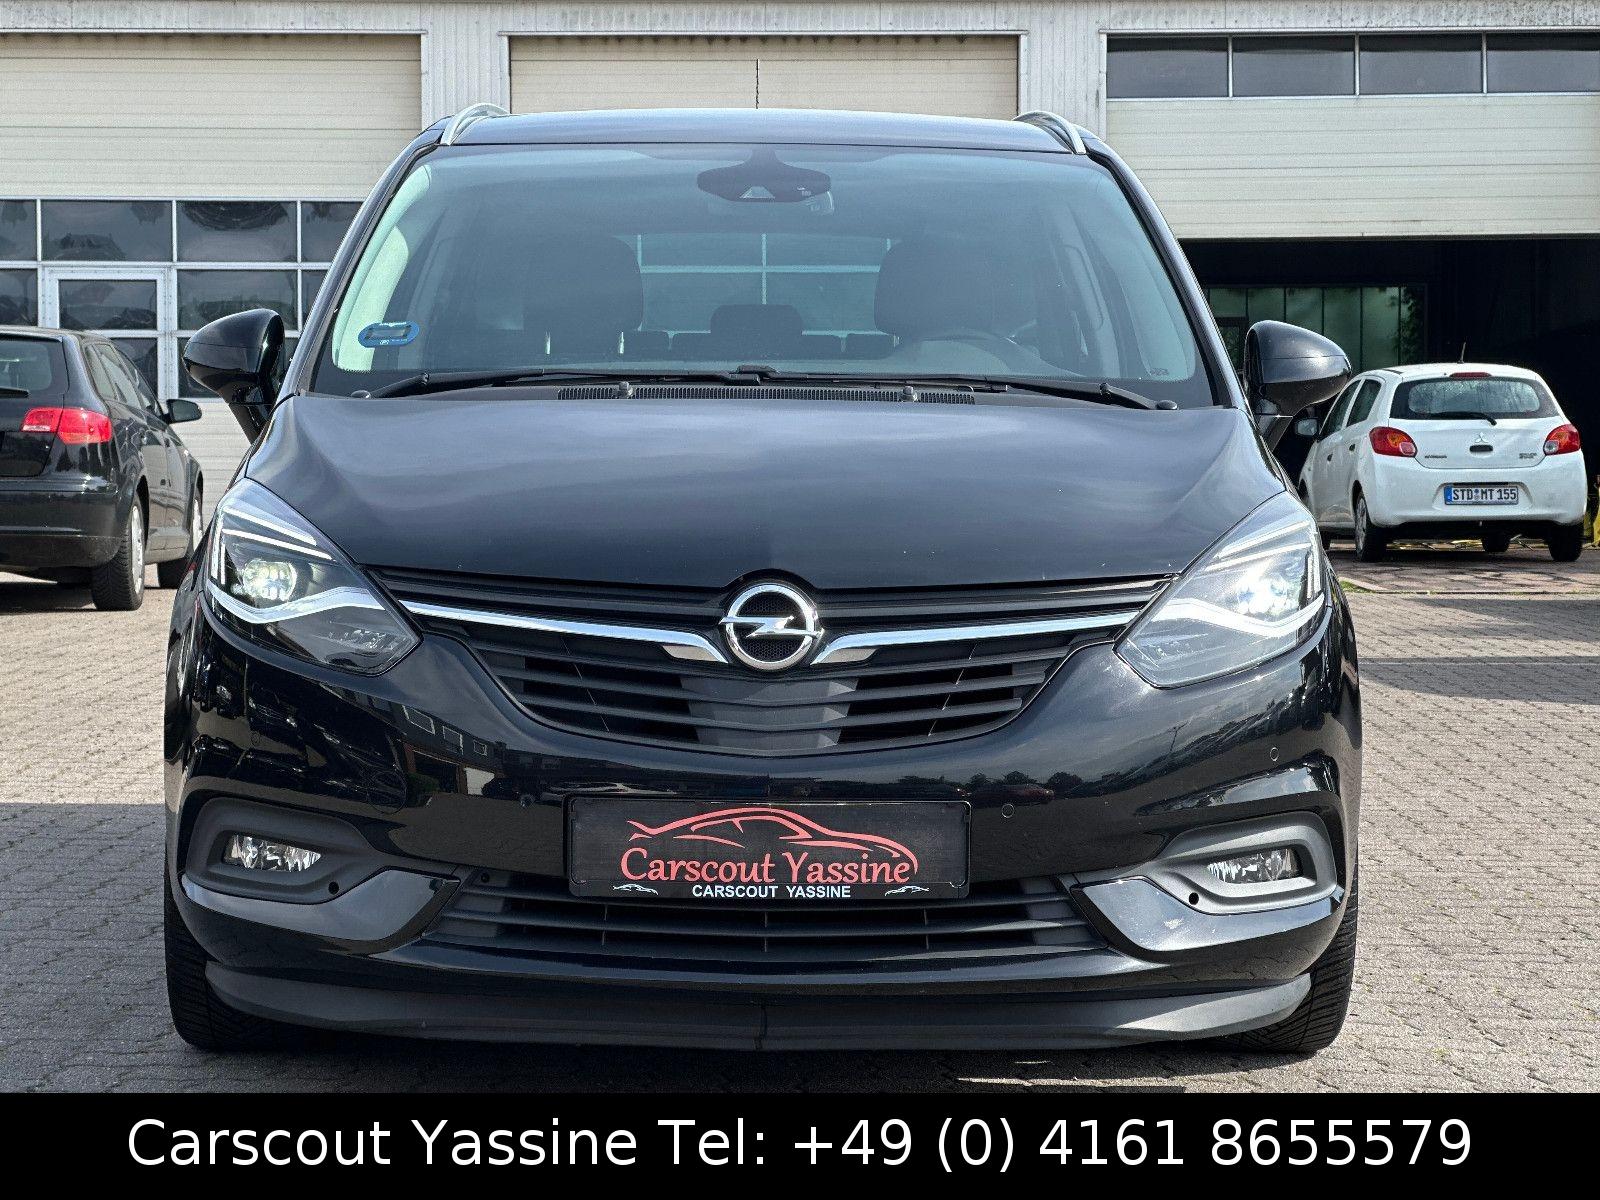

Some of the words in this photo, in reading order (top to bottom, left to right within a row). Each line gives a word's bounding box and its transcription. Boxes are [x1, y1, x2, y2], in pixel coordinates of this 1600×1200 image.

[1453, 488, 1473, 501] STD
[1497, 488, 1517, 501] 155
[620, 847, 776, 882] Carscout
[781, 852, 911, 883] Yassine
[692, 885, 777, 898] CARSCOUT
[788, 885, 852, 898] YASSINE
